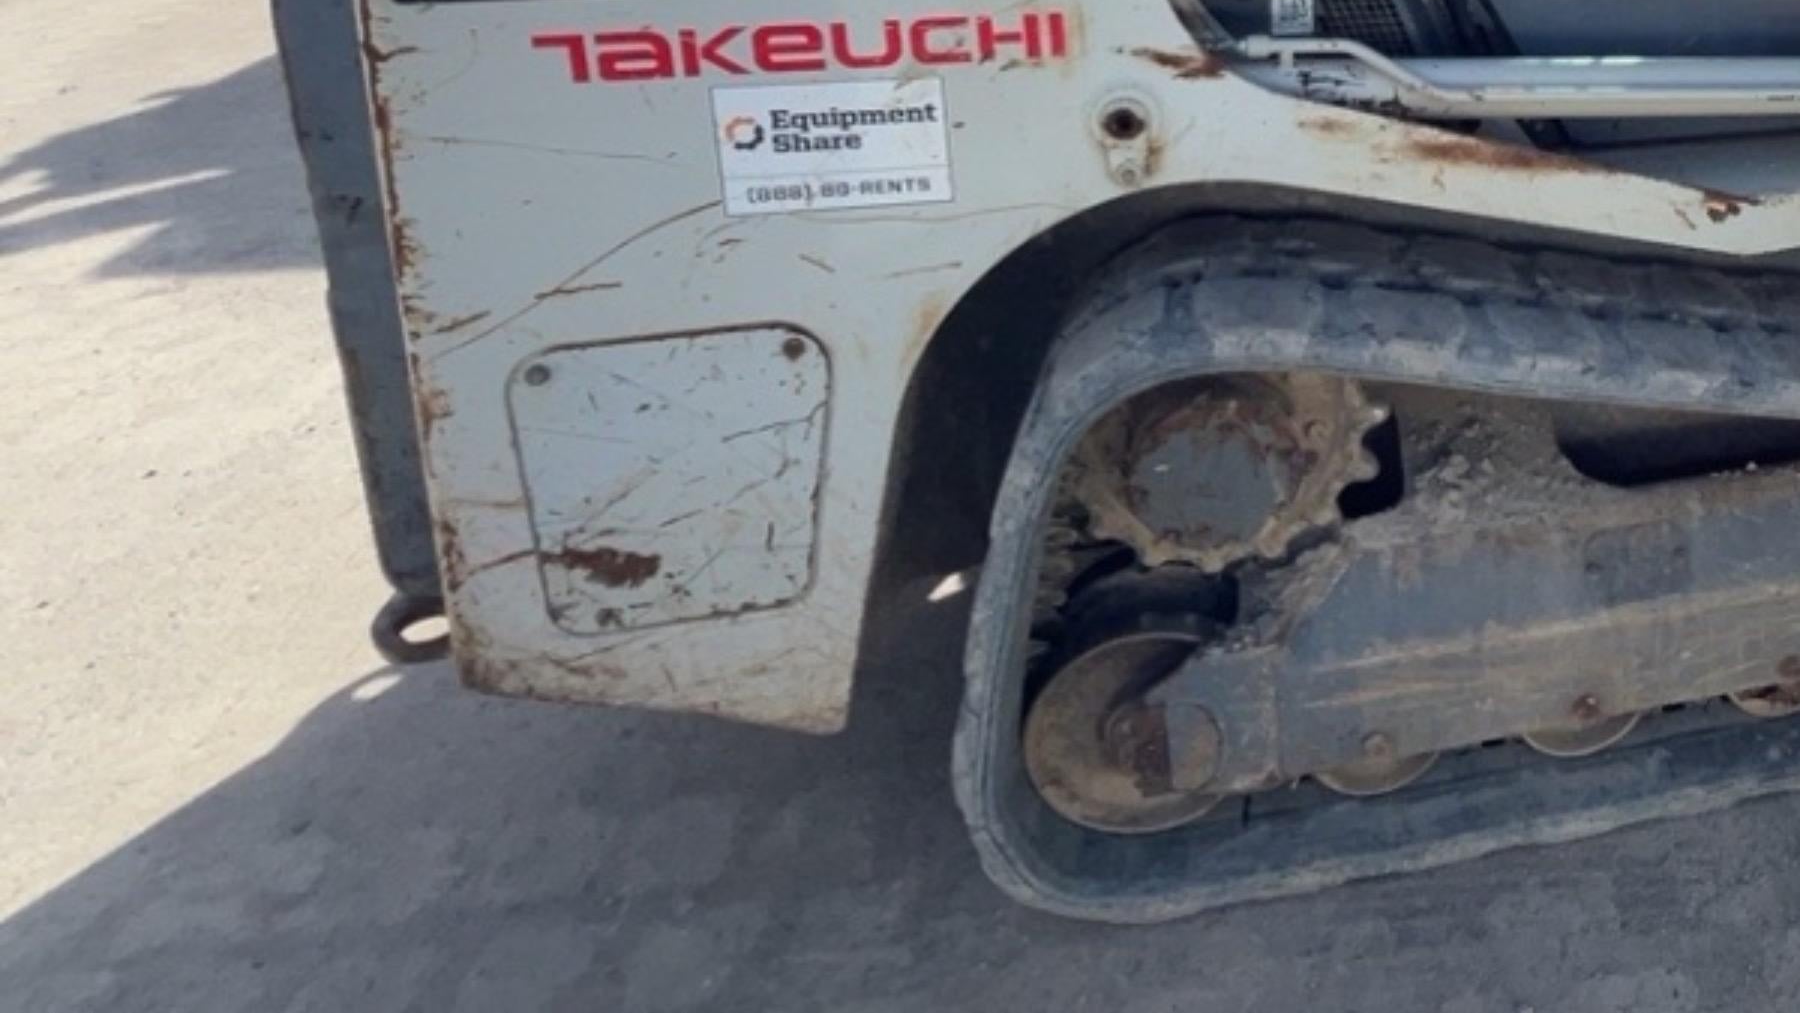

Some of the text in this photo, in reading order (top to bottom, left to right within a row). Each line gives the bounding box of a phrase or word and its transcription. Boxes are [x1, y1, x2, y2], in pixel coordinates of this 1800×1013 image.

[769, 102, 937, 132] Equipment
[771, 133, 863, 154] Share
[746, 183, 812, 204] (888)
